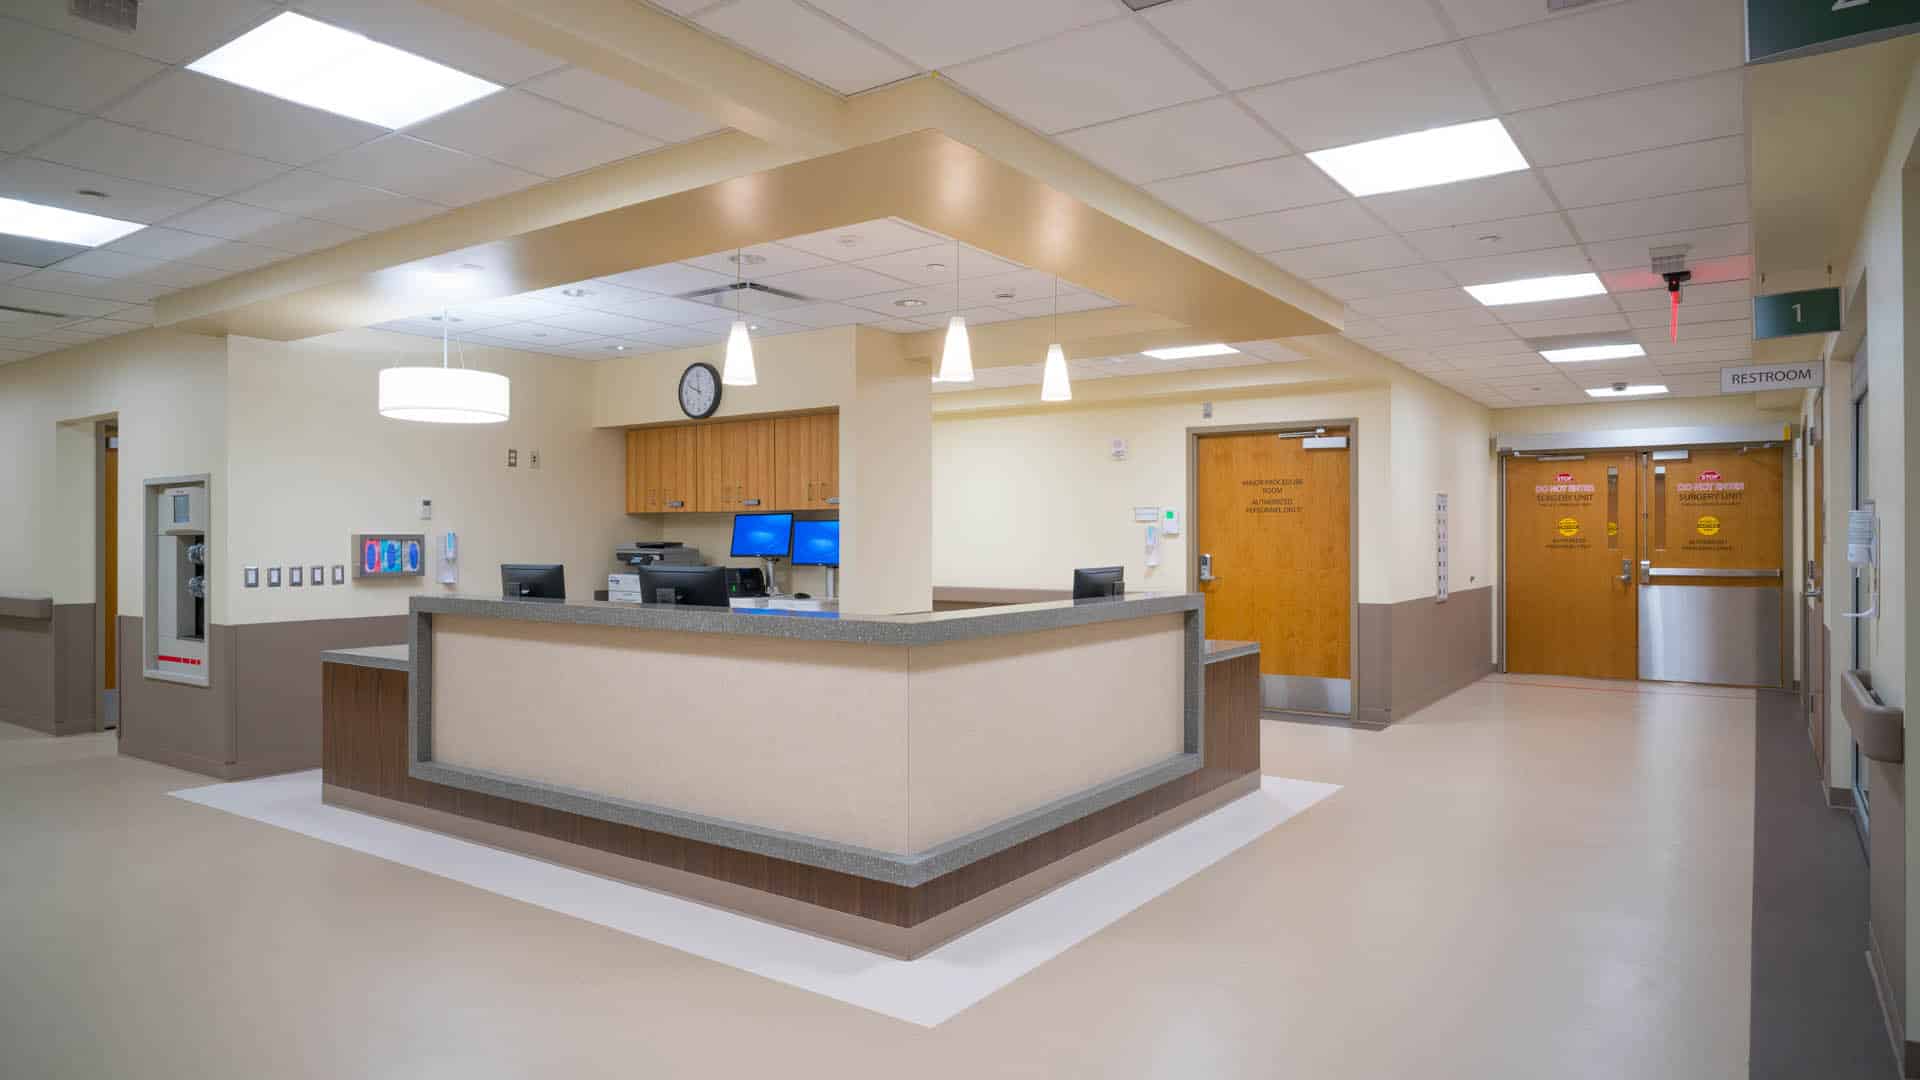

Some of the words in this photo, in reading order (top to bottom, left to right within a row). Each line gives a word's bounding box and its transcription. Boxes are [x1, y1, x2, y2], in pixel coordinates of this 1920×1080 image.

[1791, 303, 1802, 322] 1
[1731, 368, 1812, 385] RESTROOM
[1262, 487, 1283, 495] ROOM
[1679, 492, 1718, 502] SURGERY
[1721, 491, 1743, 500] UNIT
[1536, 494, 1572, 502] SURGERY
[1575, 494, 1593, 502] UNIT
